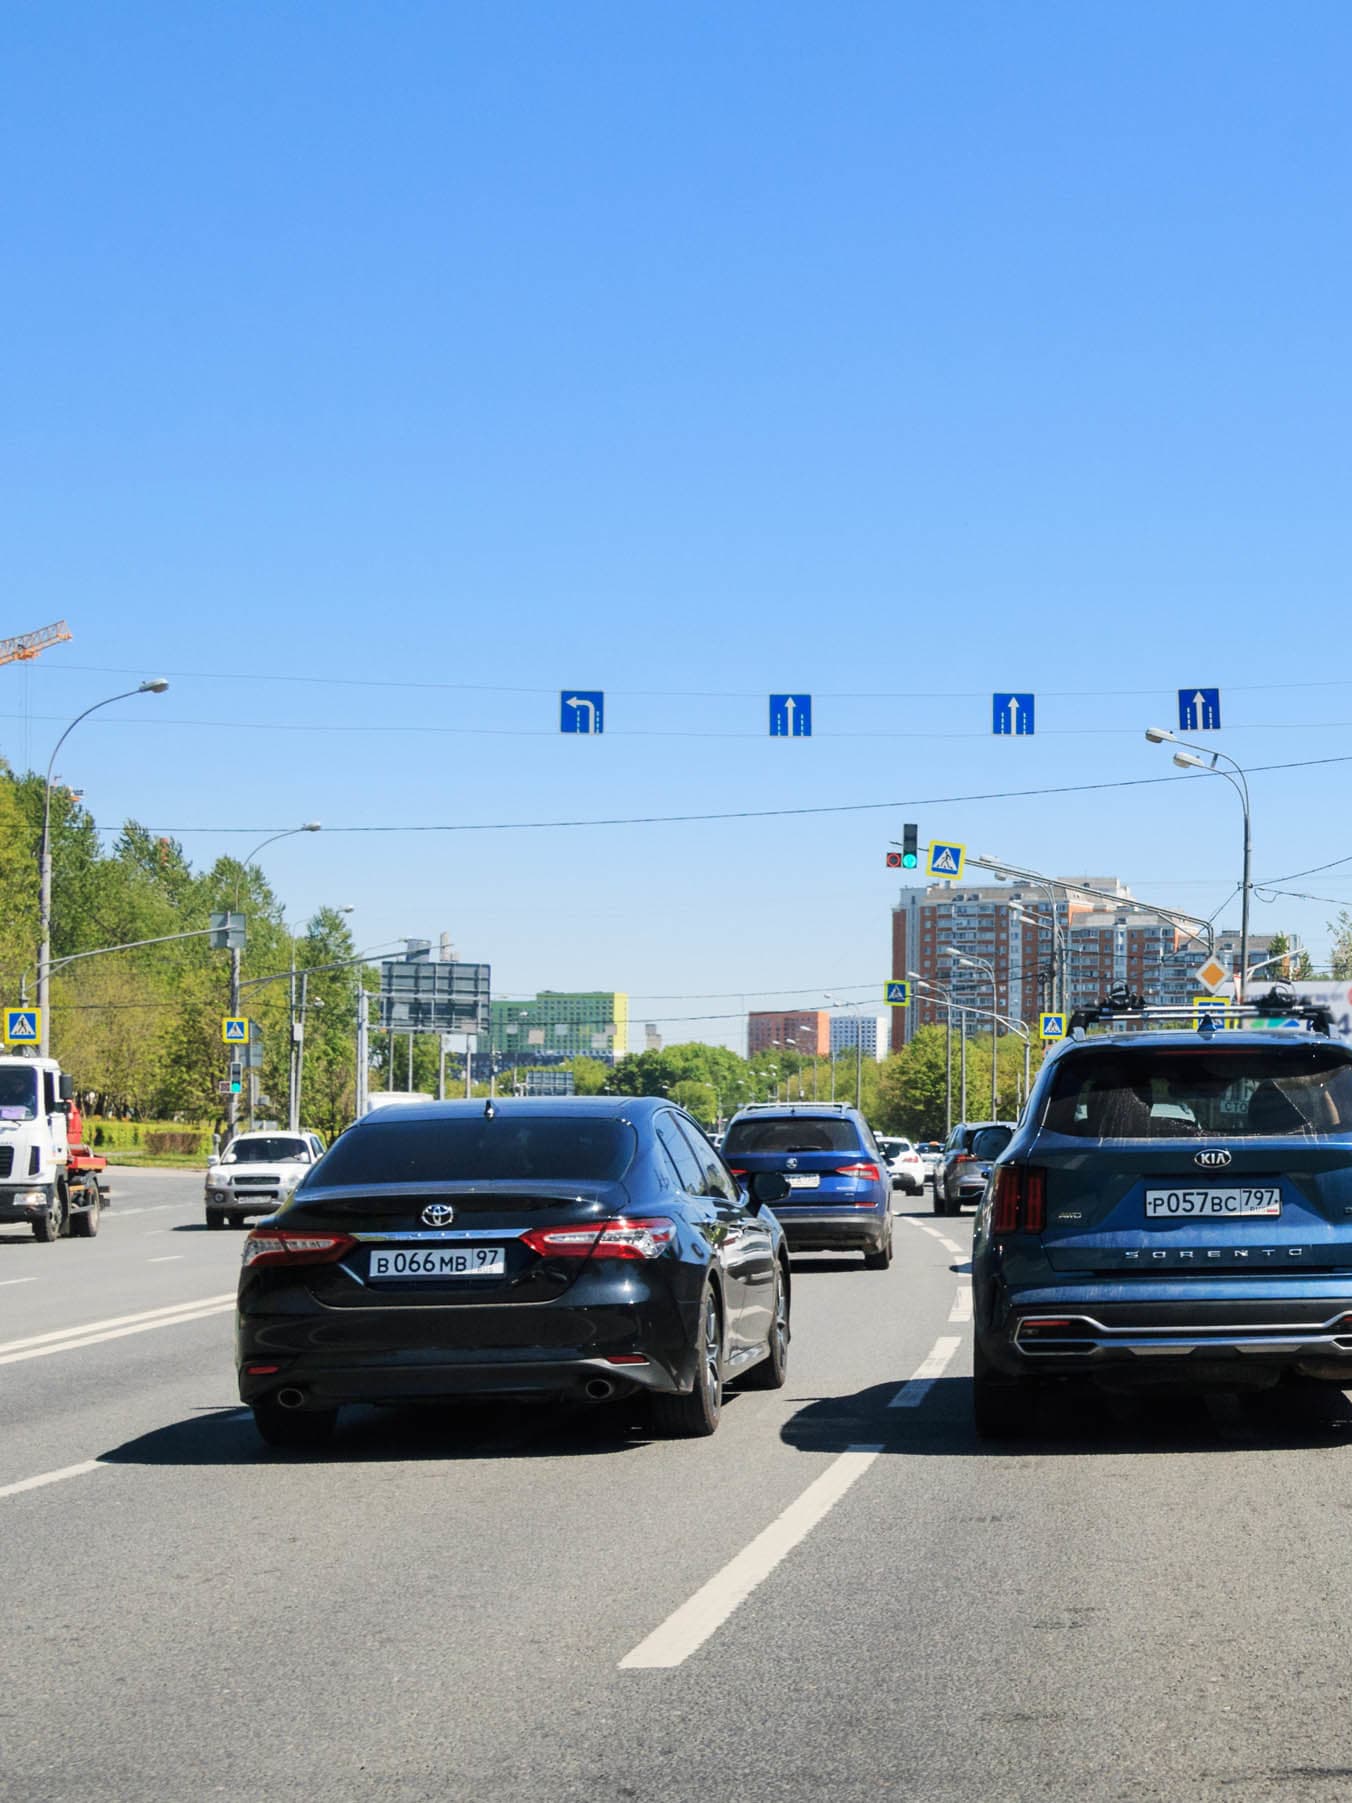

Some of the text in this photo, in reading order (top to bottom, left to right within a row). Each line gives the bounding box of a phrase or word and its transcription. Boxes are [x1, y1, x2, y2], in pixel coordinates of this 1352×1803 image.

[1224, 1102, 1249, 1113] СТО
[1200, 1153, 1226, 1164] KIA
[1242, 1190, 1275, 1206] 797
[476, 1250, 498, 1265] 97
[1125, 1248, 1303, 1259] SORENTO
